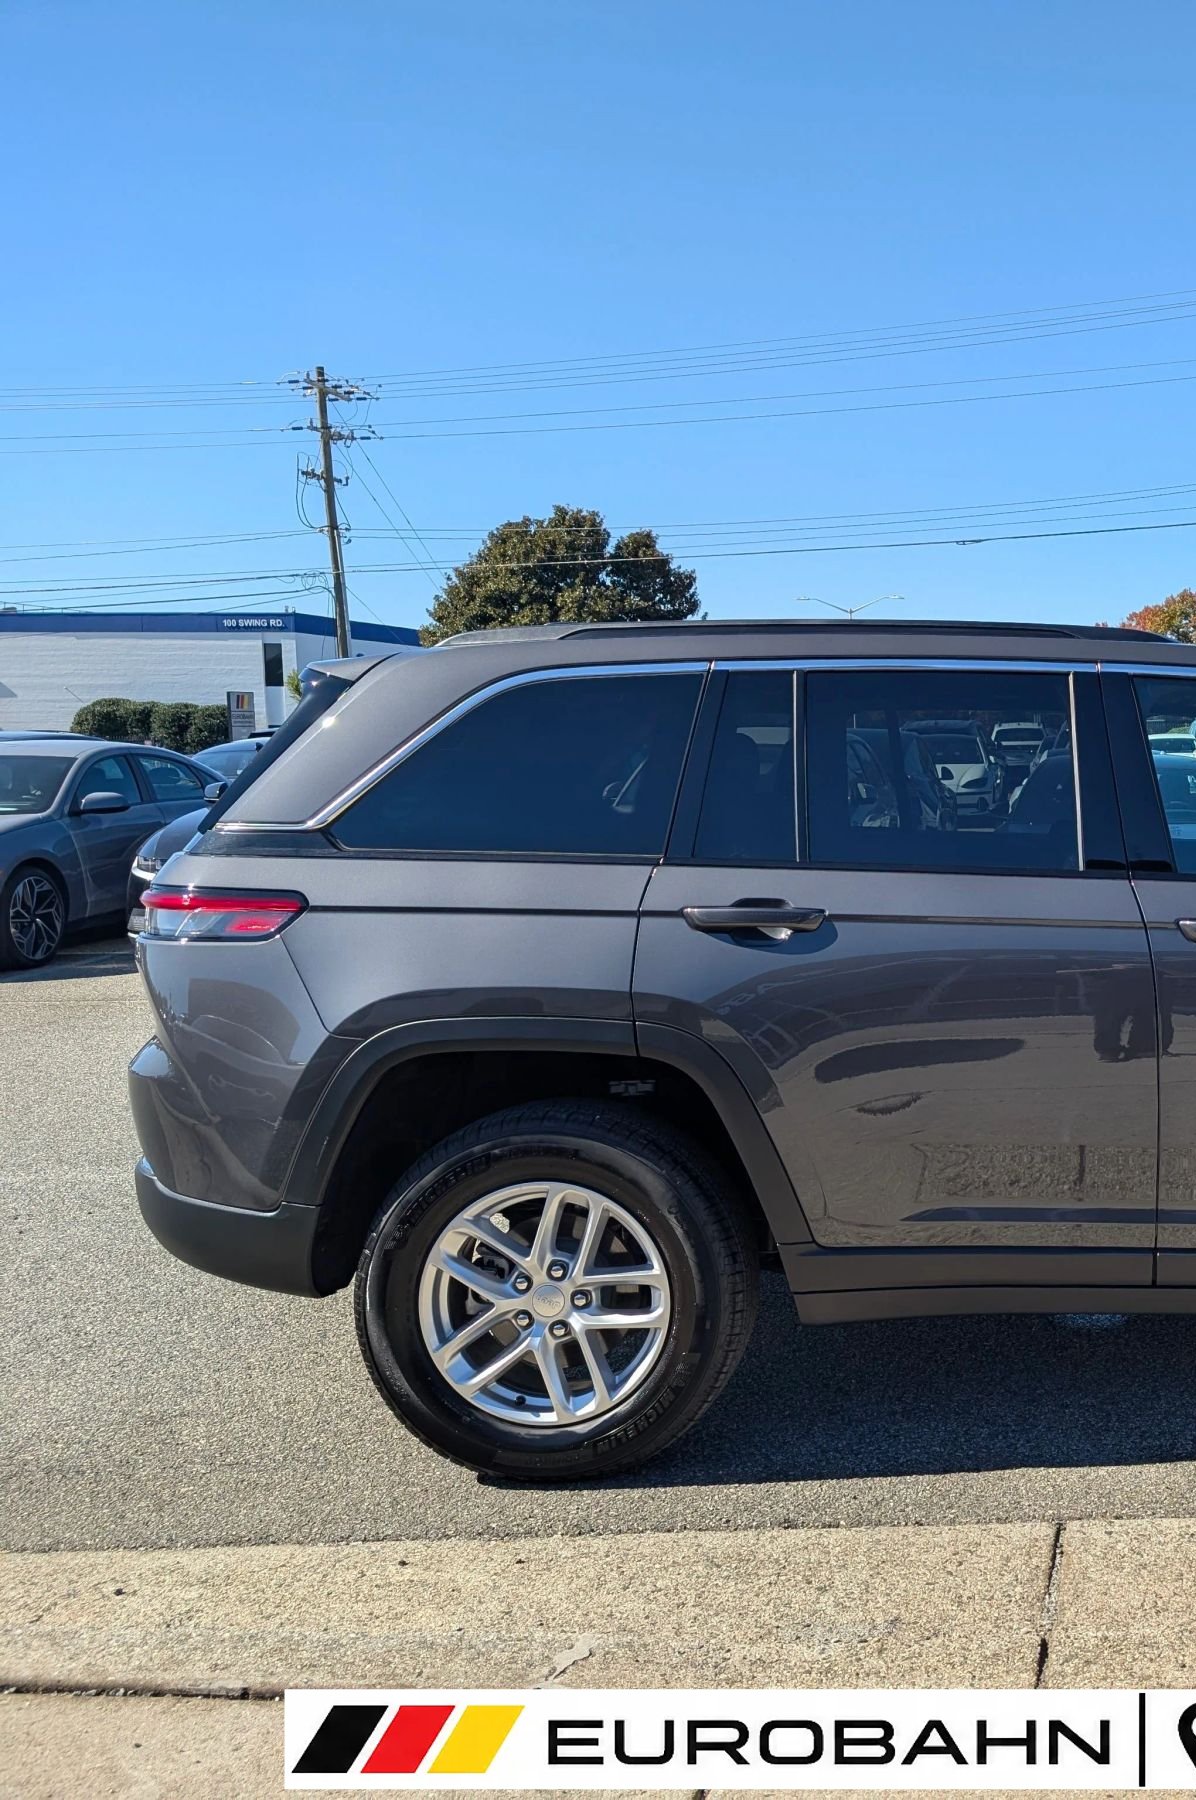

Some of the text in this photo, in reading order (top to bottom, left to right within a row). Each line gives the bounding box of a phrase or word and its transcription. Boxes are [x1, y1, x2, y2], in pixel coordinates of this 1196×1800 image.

[222, 618, 285, 627] 100 SWING RD.
